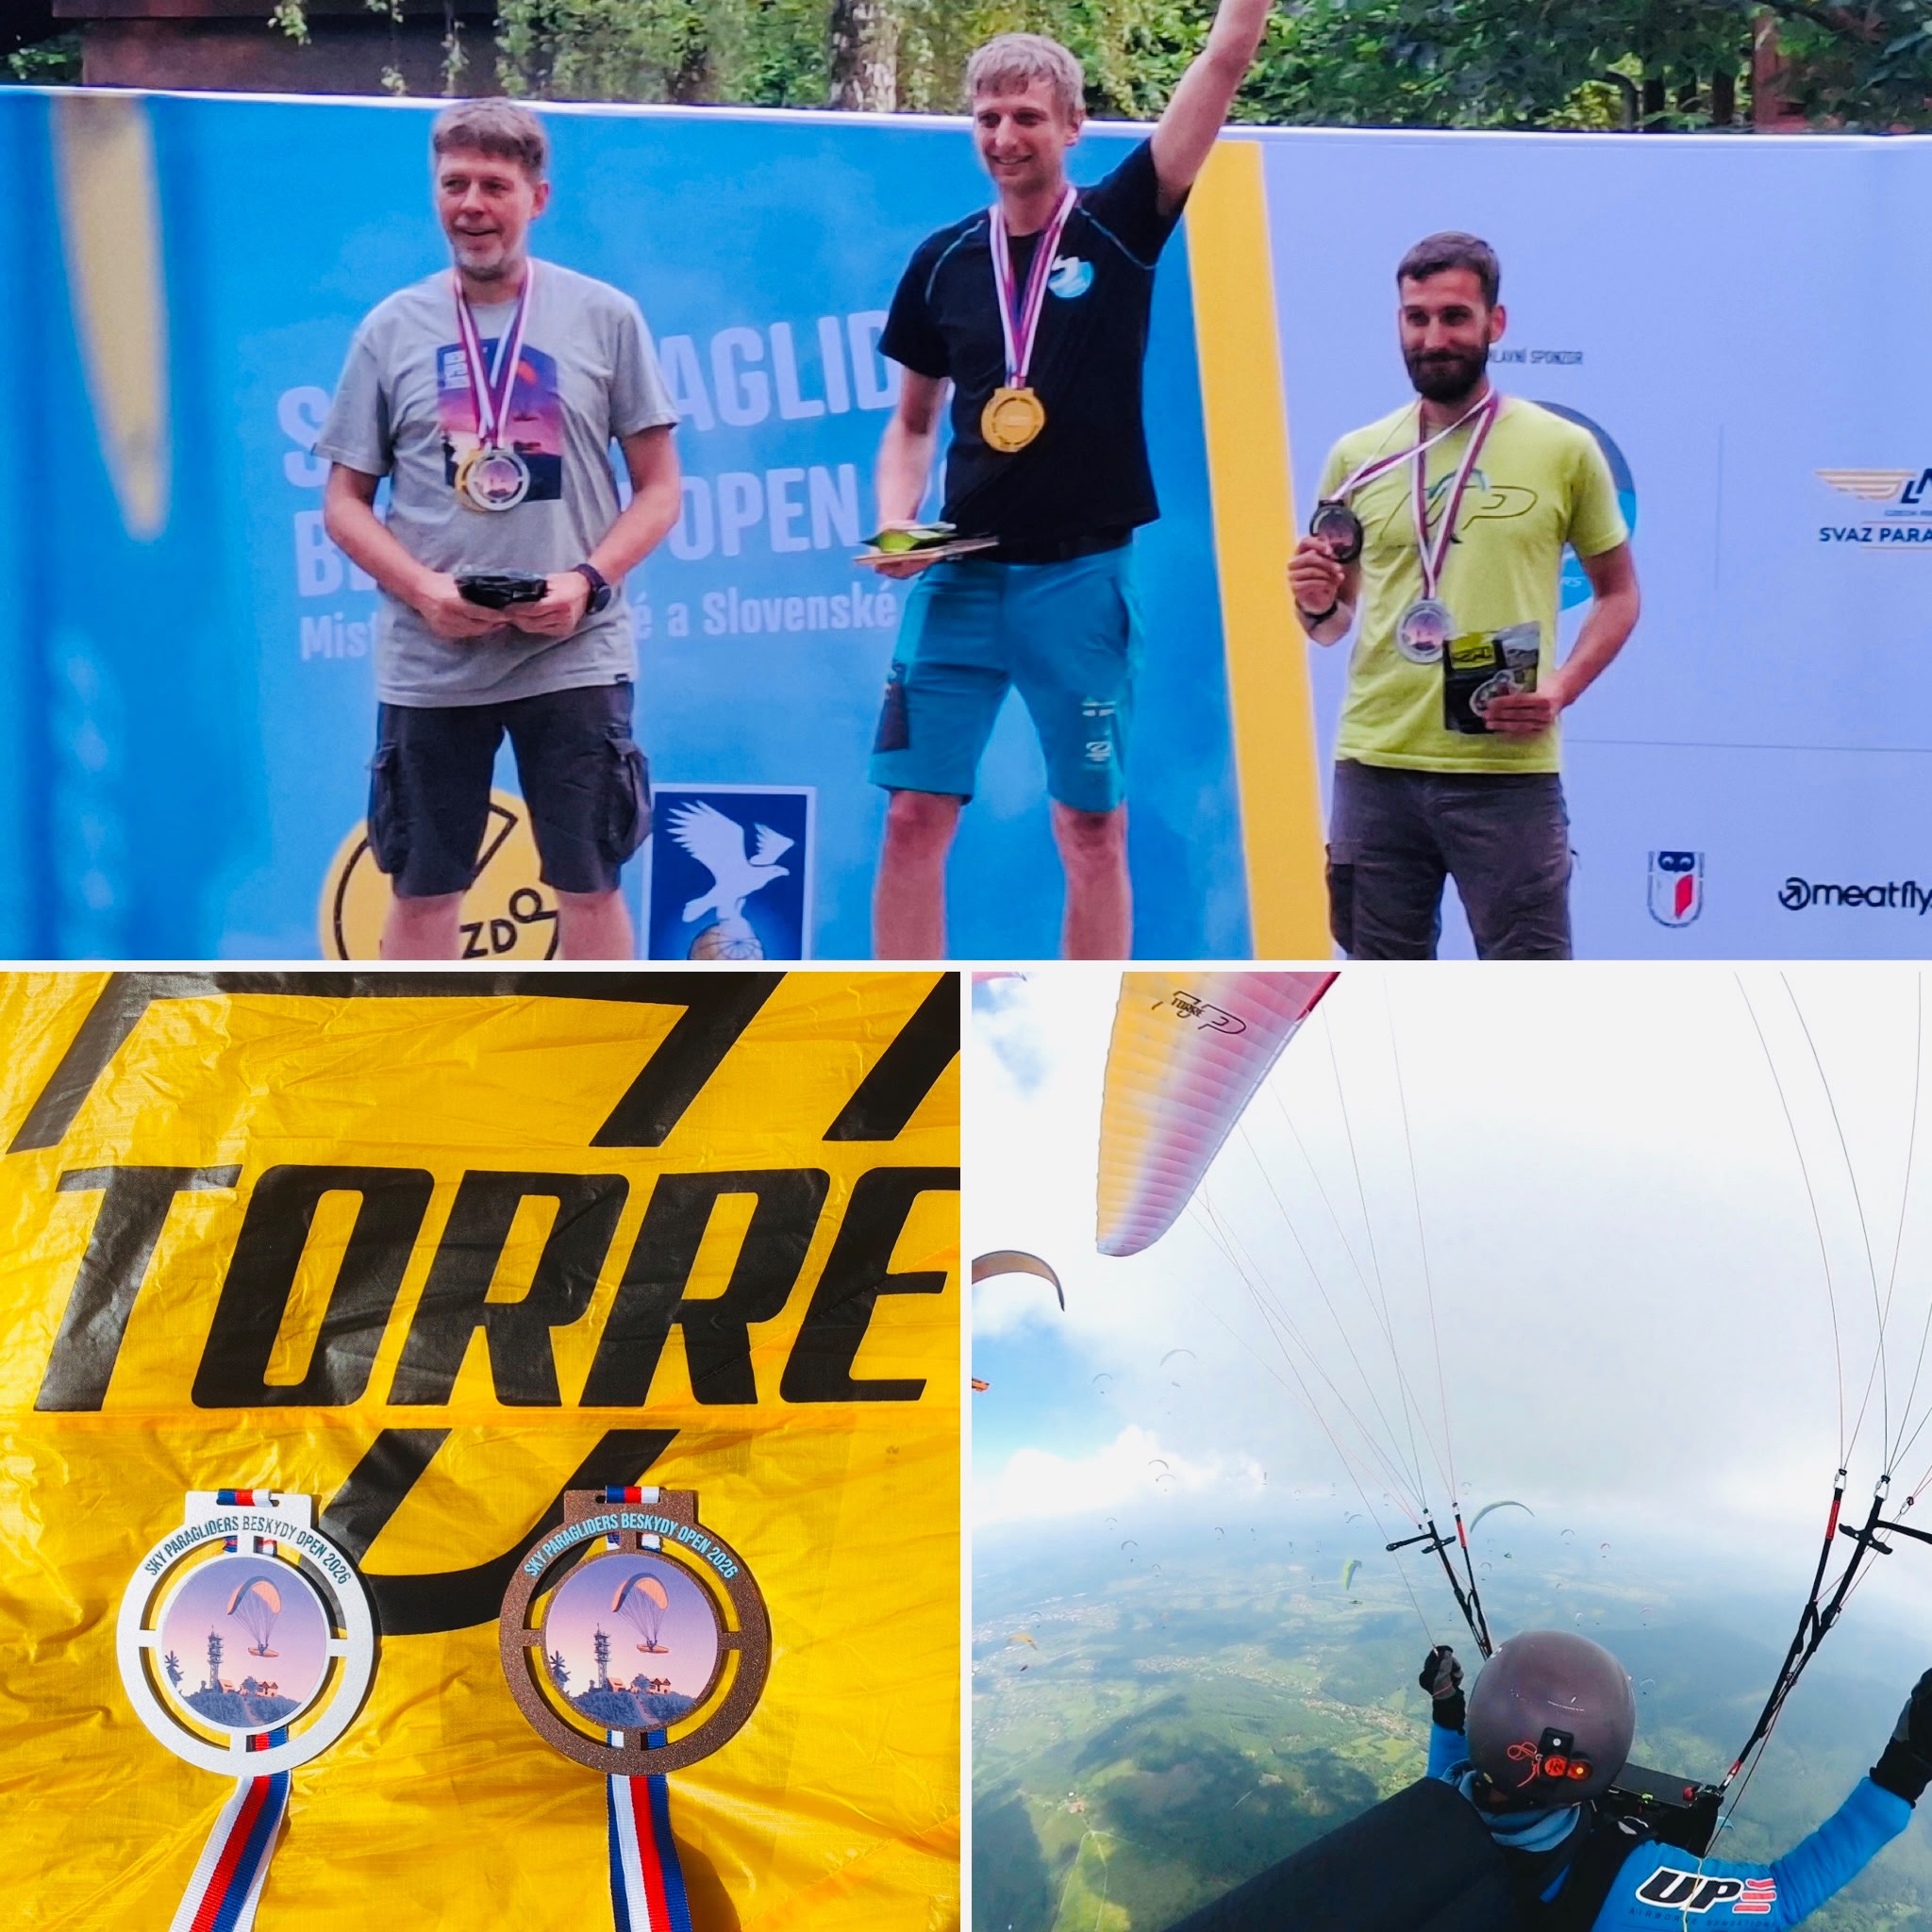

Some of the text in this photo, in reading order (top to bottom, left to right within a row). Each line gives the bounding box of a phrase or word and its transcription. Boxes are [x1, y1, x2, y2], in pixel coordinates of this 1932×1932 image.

[659, 309, 900, 431] AGLID
[669, 463, 860, 560] OPEN
[1819, 526, 1873, 542] SVAZ
[666, 601, 690, 638] a
[702, 581, 897, 637] Slovenské
[34, 1163, 960, 1412] TORRE
[144, 1515, 352, 1585] SKY PARAGLIDERS BESKYDY OPEN 2026
[524, 1512, 740, 1579] SKY PARAGLIDERS BESKYDY OPEN 2026
[1636, 1866, 1744, 1913] UP
